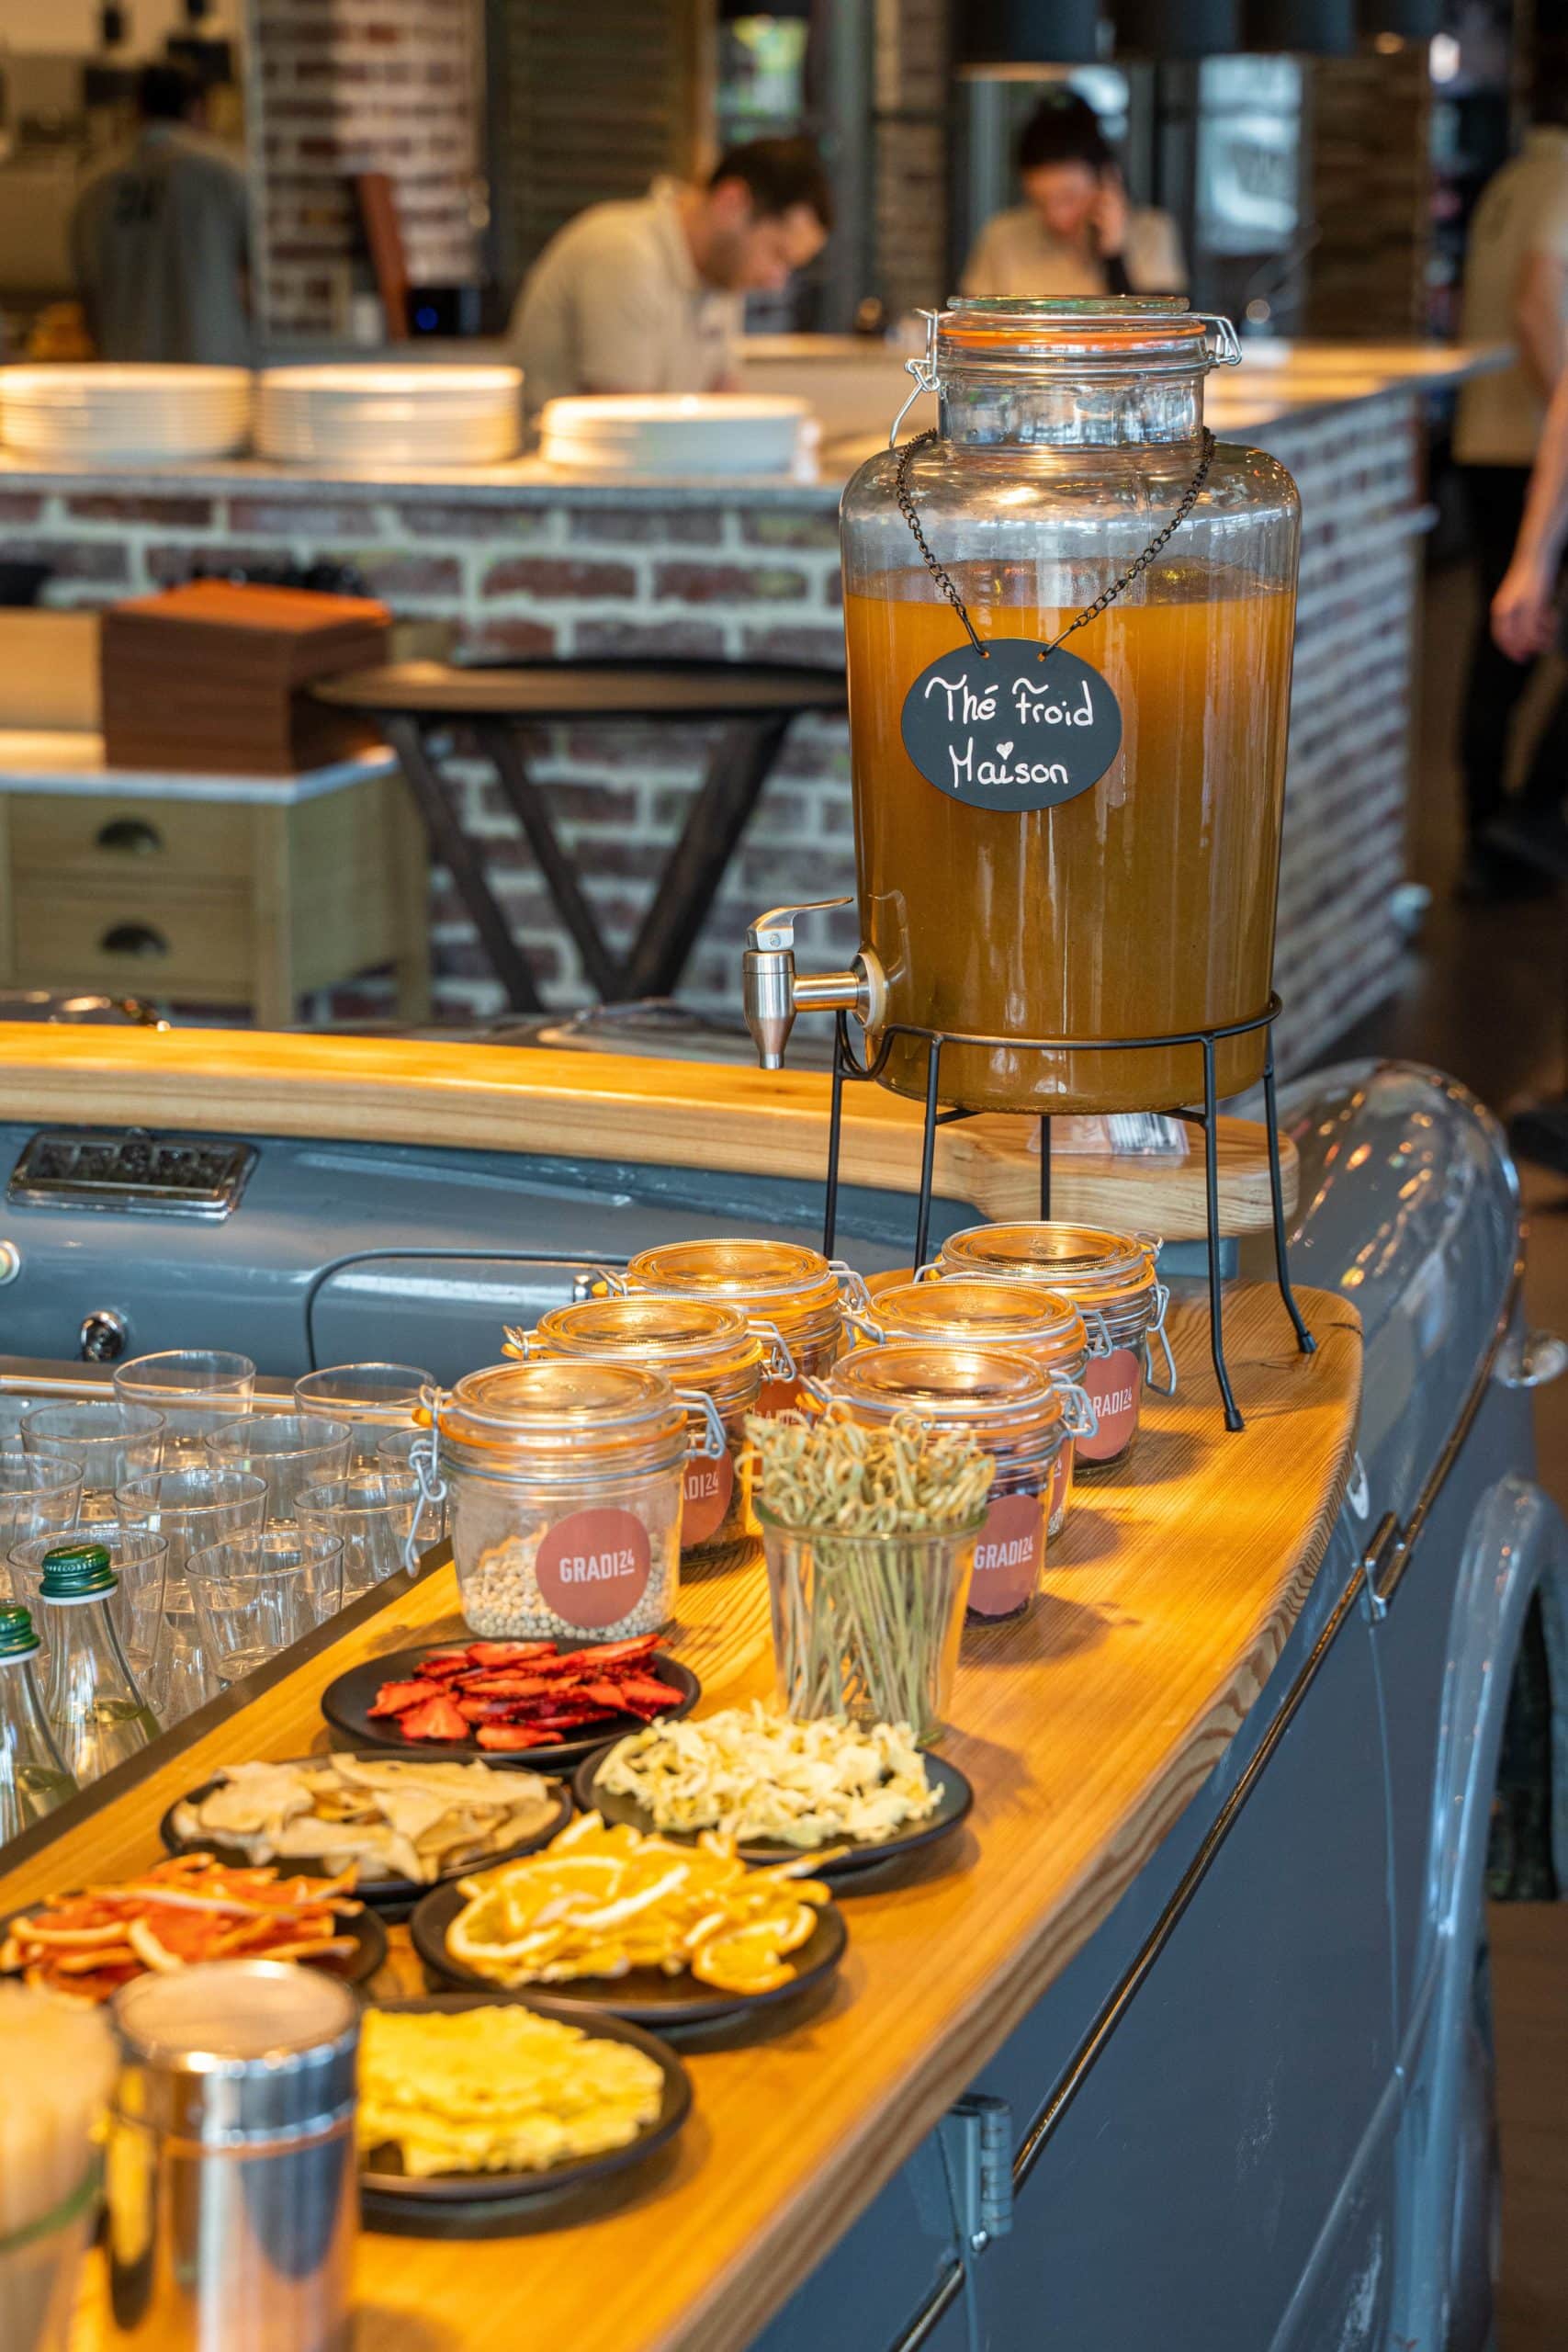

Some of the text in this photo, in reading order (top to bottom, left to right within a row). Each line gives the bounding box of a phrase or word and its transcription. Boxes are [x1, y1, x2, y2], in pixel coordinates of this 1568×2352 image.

[924, 673, 999, 725] Thé
[948, 736, 1069, 788] Maison
[1091, 1385, 1133, 1418] RADI24
[558, 1548, 636, 1584] GRADI24
[974, 1535, 1034, 1570] GRADI24
